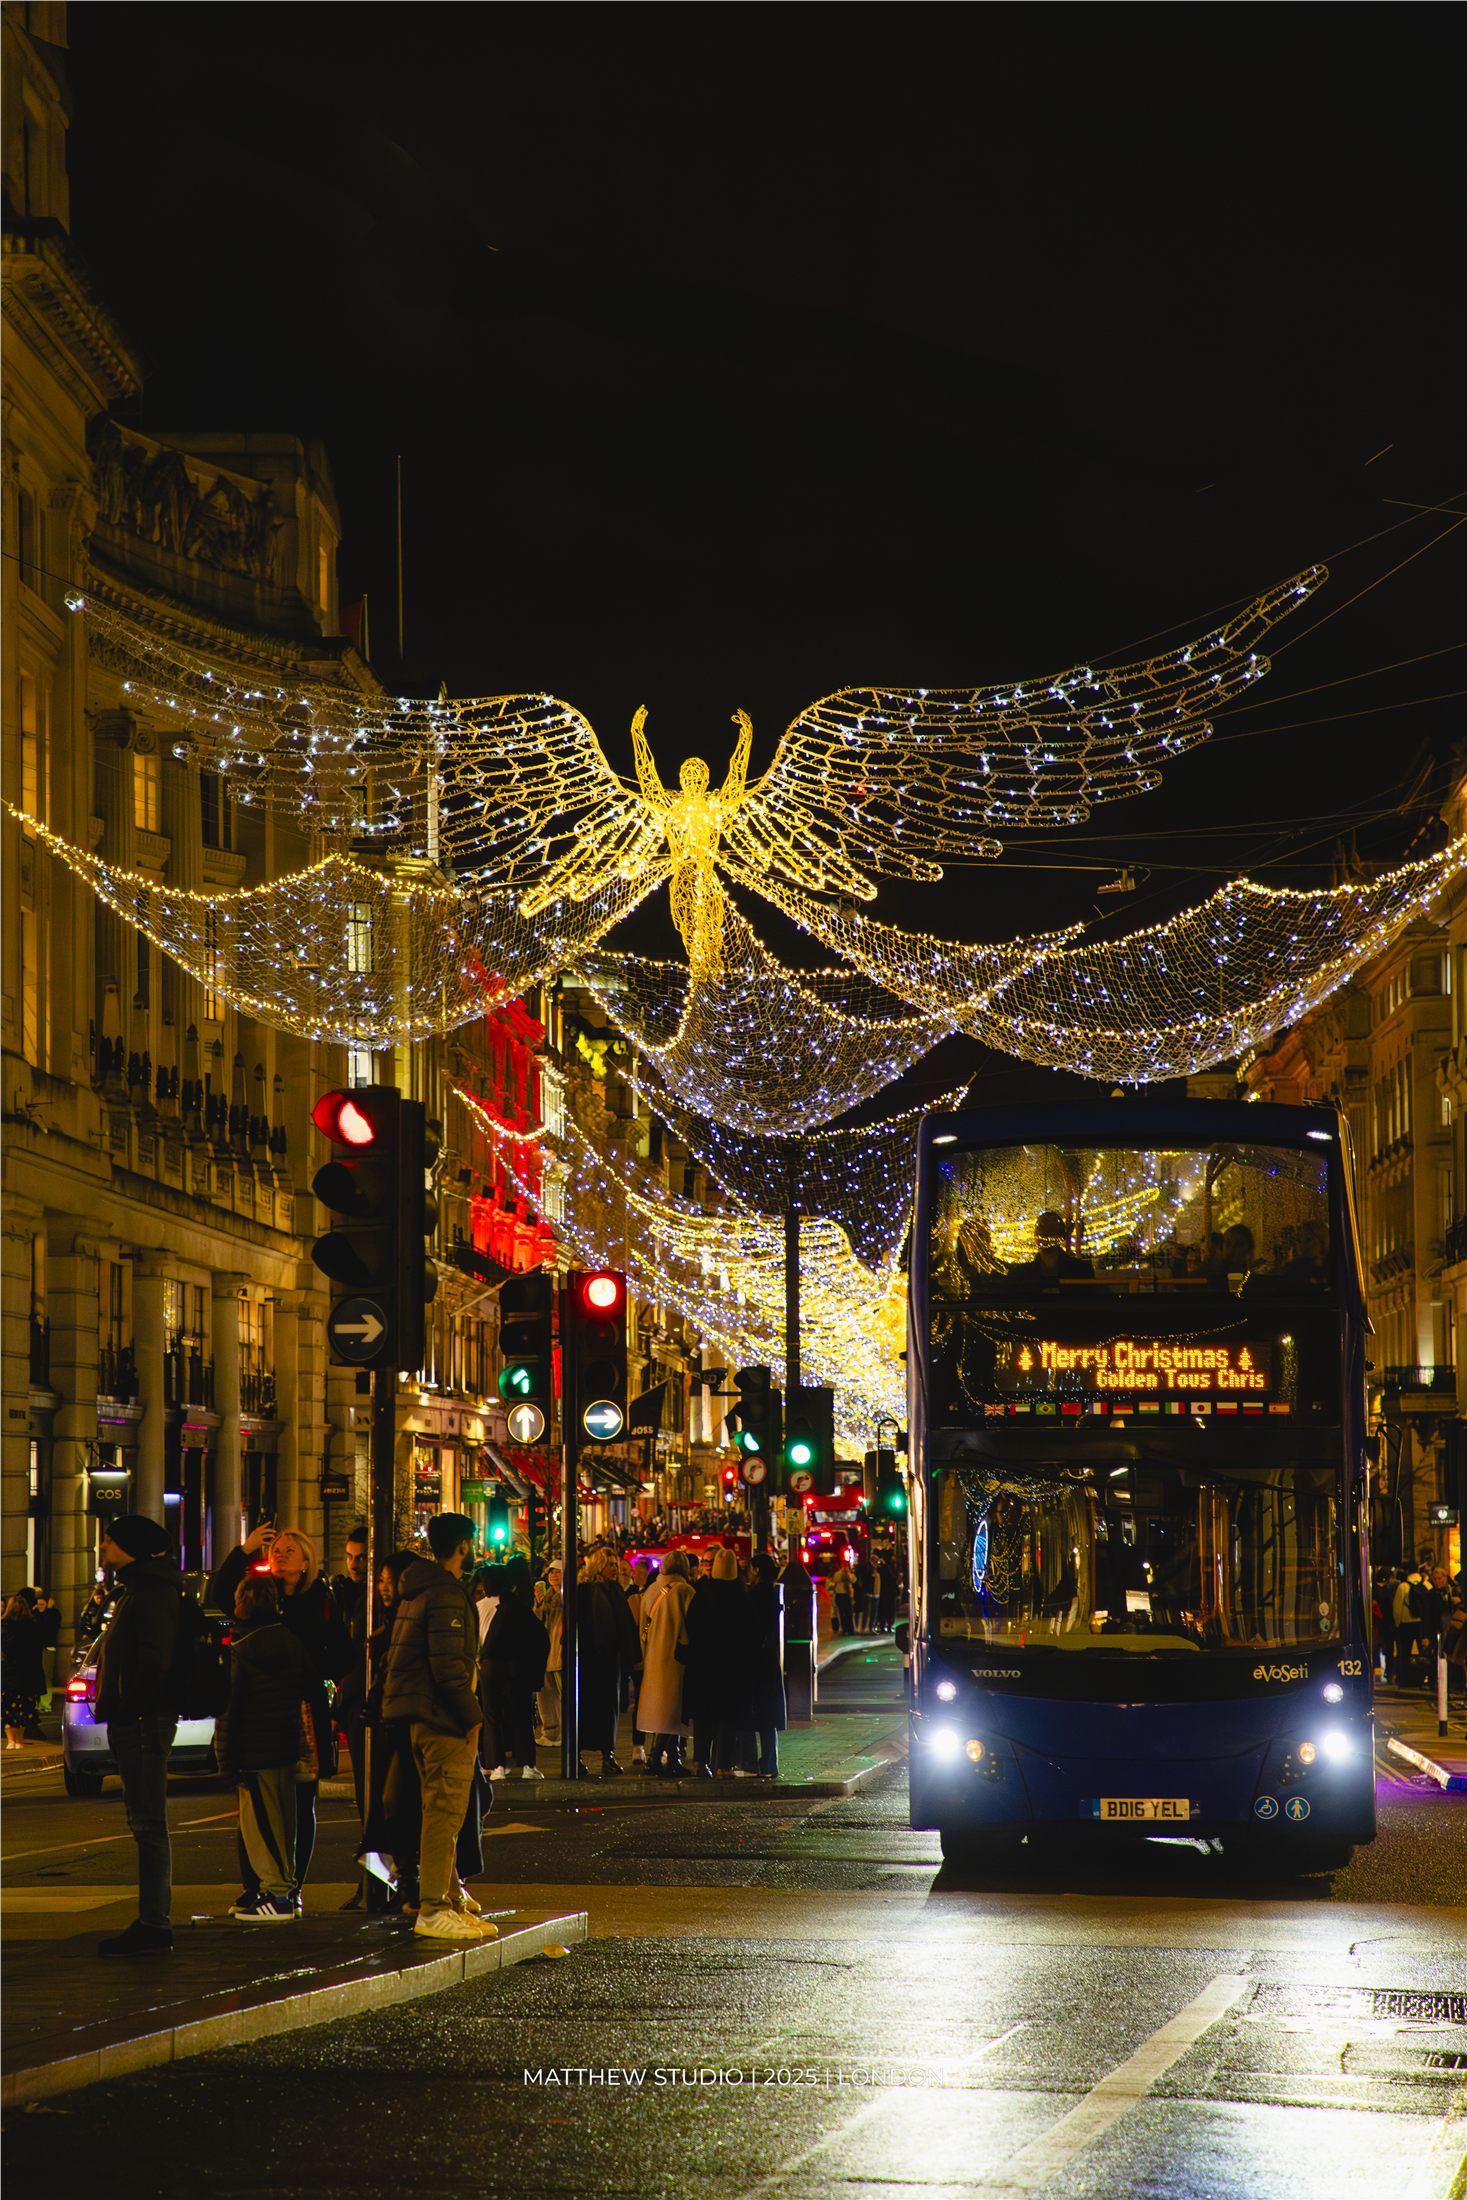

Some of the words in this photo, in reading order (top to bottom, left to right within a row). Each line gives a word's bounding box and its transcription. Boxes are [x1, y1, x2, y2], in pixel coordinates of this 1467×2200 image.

[1041, 1342, 1108, 1369] Merry
[1114, 1342, 1230, 1369] Christmas
[1096, 1369, 1158, 1388] Golden
[1164, 1369, 1211, 1388] Tous
[1217, 1369, 1265, 1388] Chris
[96, 1489, 121, 1500] COS
[970, 1668, 1022, 1680] VOLVO
[1337, 1659, 1363, 1676] 132
[1107, 1801, 1146, 1818] BD16
[1150, 1801, 1184, 1818] YEL
